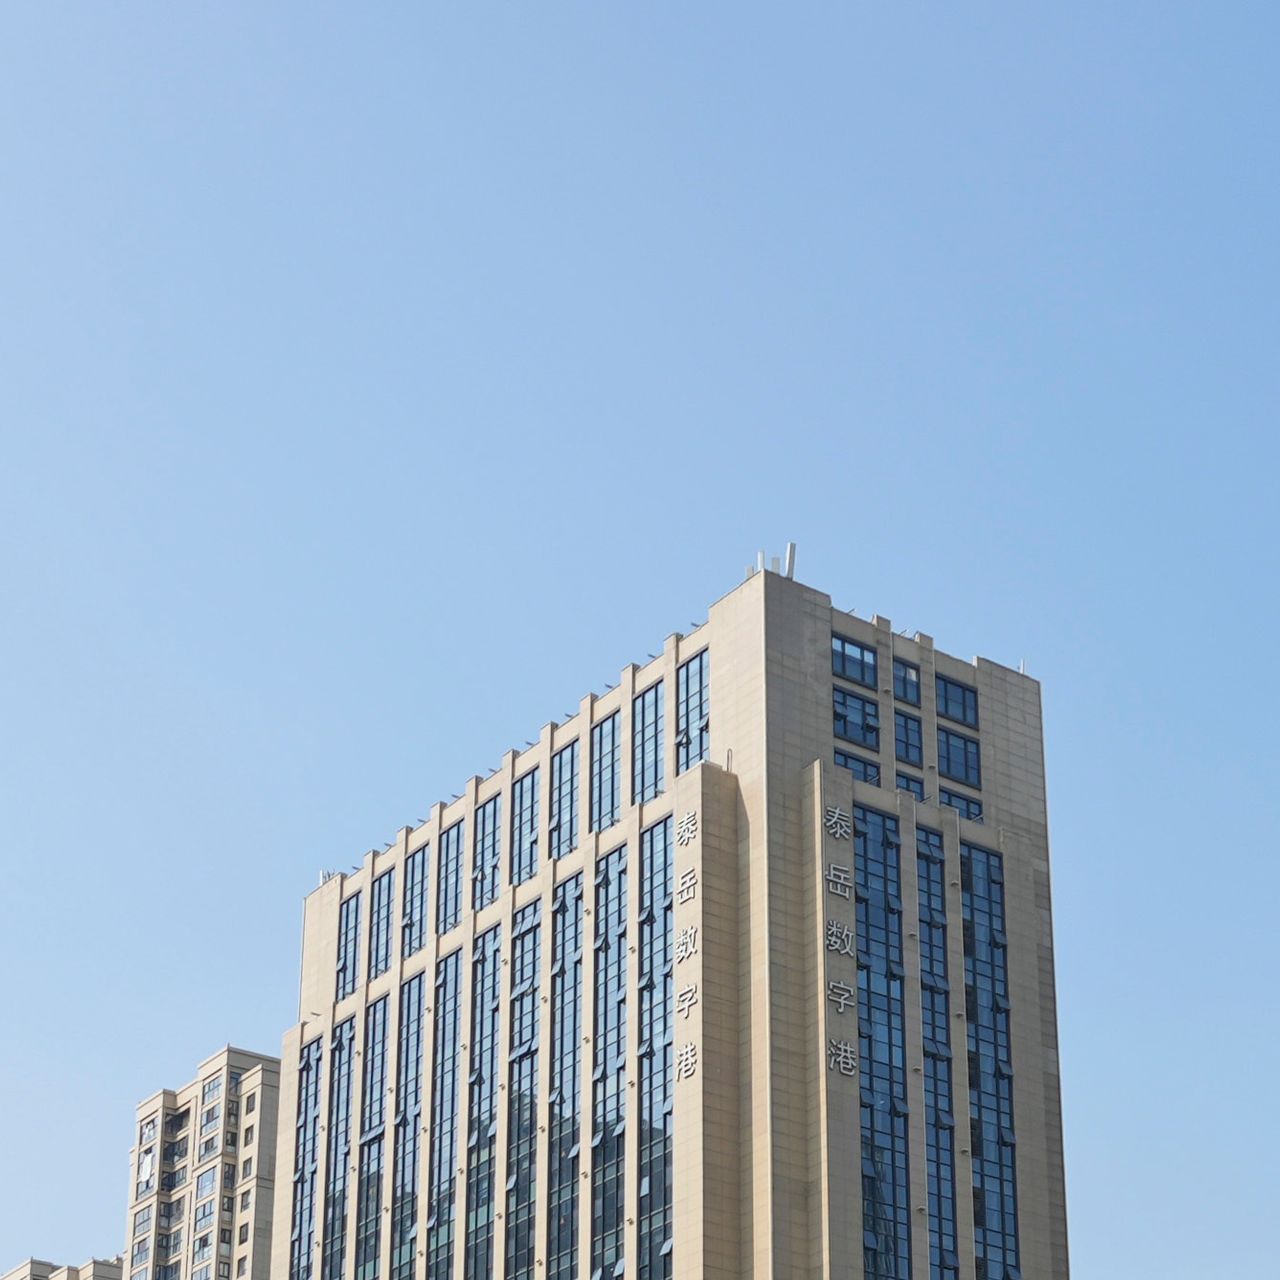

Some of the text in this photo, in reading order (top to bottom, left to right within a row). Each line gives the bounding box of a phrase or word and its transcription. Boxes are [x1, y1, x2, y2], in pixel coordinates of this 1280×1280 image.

[675, 810, 699, 1082] 泰岳数字港
[824, 805, 858, 1078] 泰岳数字港
